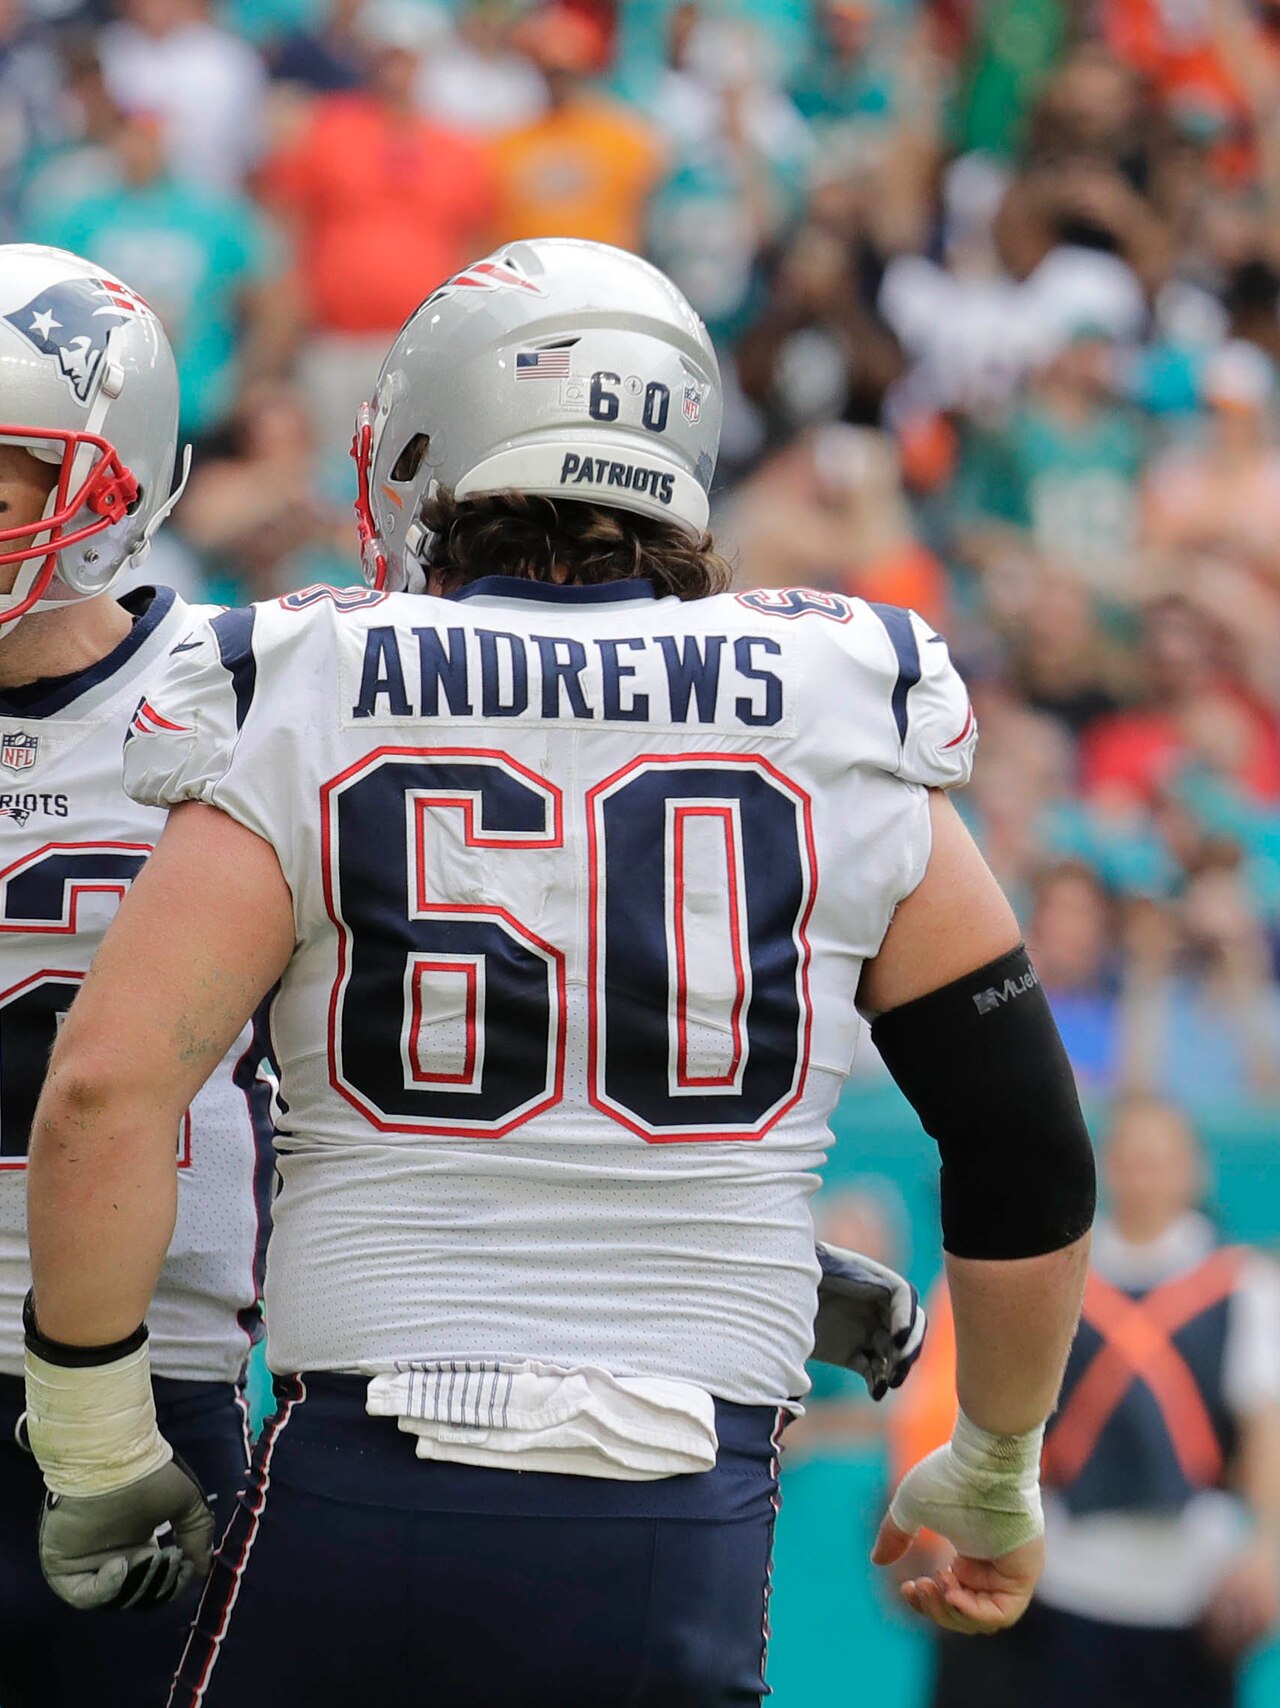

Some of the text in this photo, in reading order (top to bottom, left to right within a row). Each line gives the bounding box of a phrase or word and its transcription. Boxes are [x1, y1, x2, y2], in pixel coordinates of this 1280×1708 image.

[560, 452, 676, 504] PATRIOTS
[352, 625, 783, 727] ANDREWS
[3, 747, 34, 767] NFL
[319, 745, 818, 1144] 60
